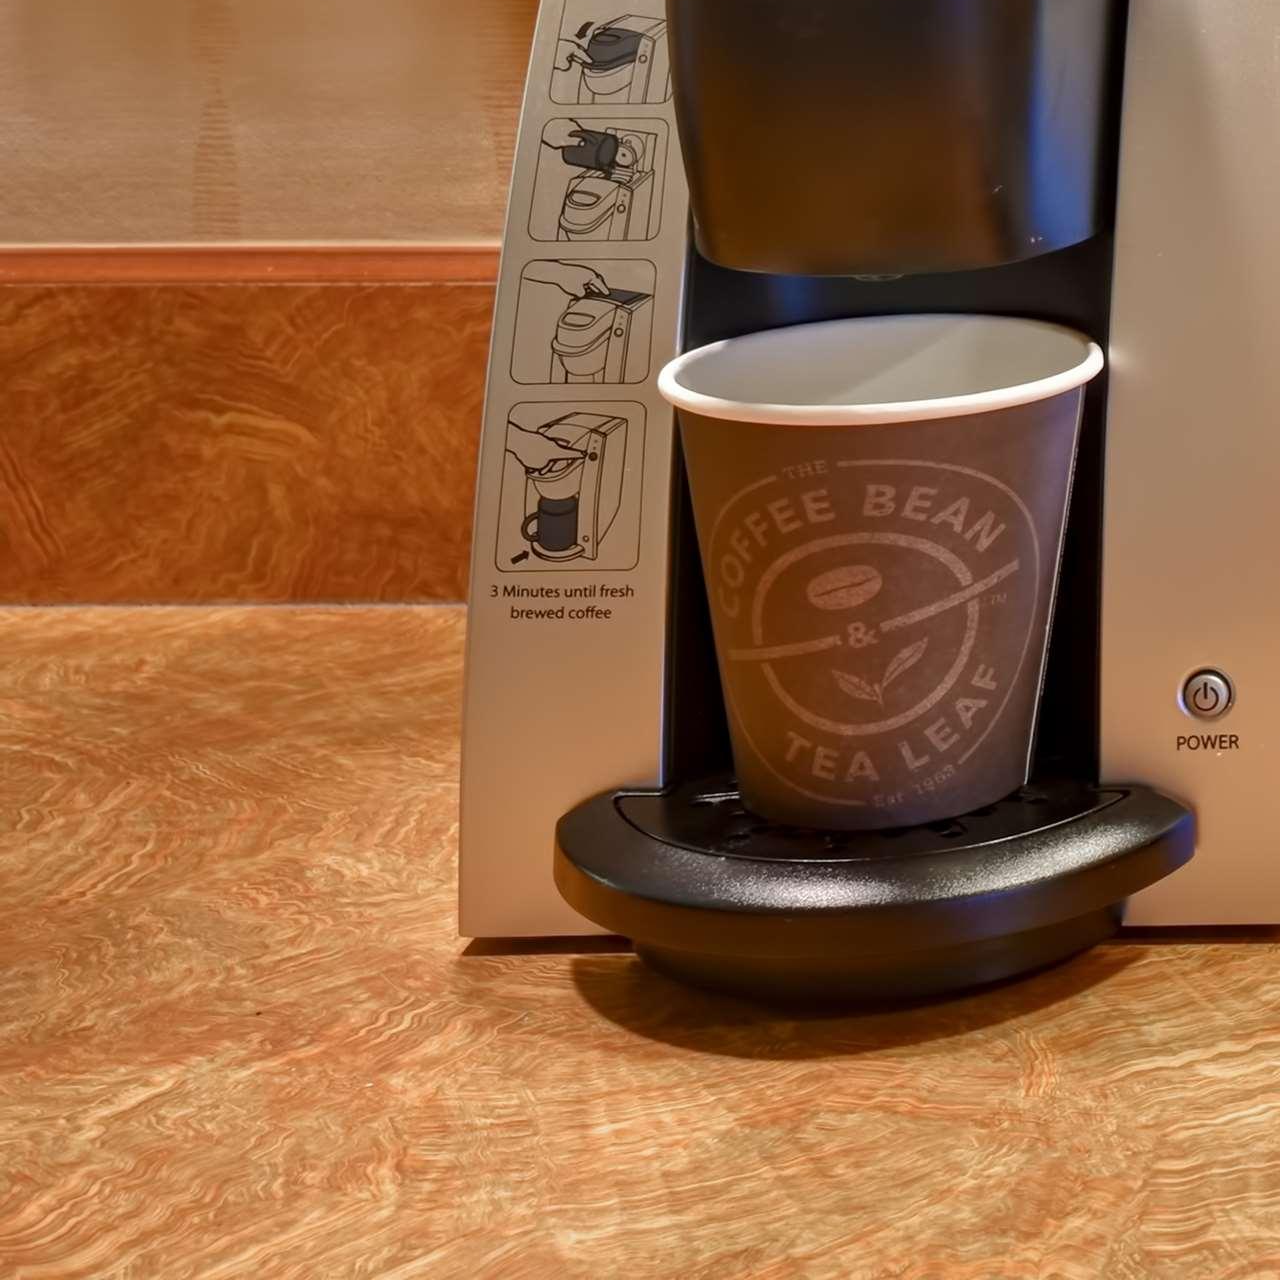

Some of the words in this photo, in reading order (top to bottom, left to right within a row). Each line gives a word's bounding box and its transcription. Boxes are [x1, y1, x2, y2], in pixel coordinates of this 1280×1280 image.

[782, 459, 830, 480] THE
[717, 488, 836, 619] COFFEE
[862, 483, 1007, 553] BEAN
[490, 584, 499, 598] 3
[502, 584, 561, 598] Minutes
[564, 584, 597, 598] until
[600, 584, 635, 598] fresh
[510, 605, 565, 619] brewed
[568, 605, 612, 619] coffee
[847, 621, 879, 649] &
[784, 731, 881, 782] TEA
[901, 663, 1000, 769] LEAF
[1176, 734, 1240, 751] POWER
